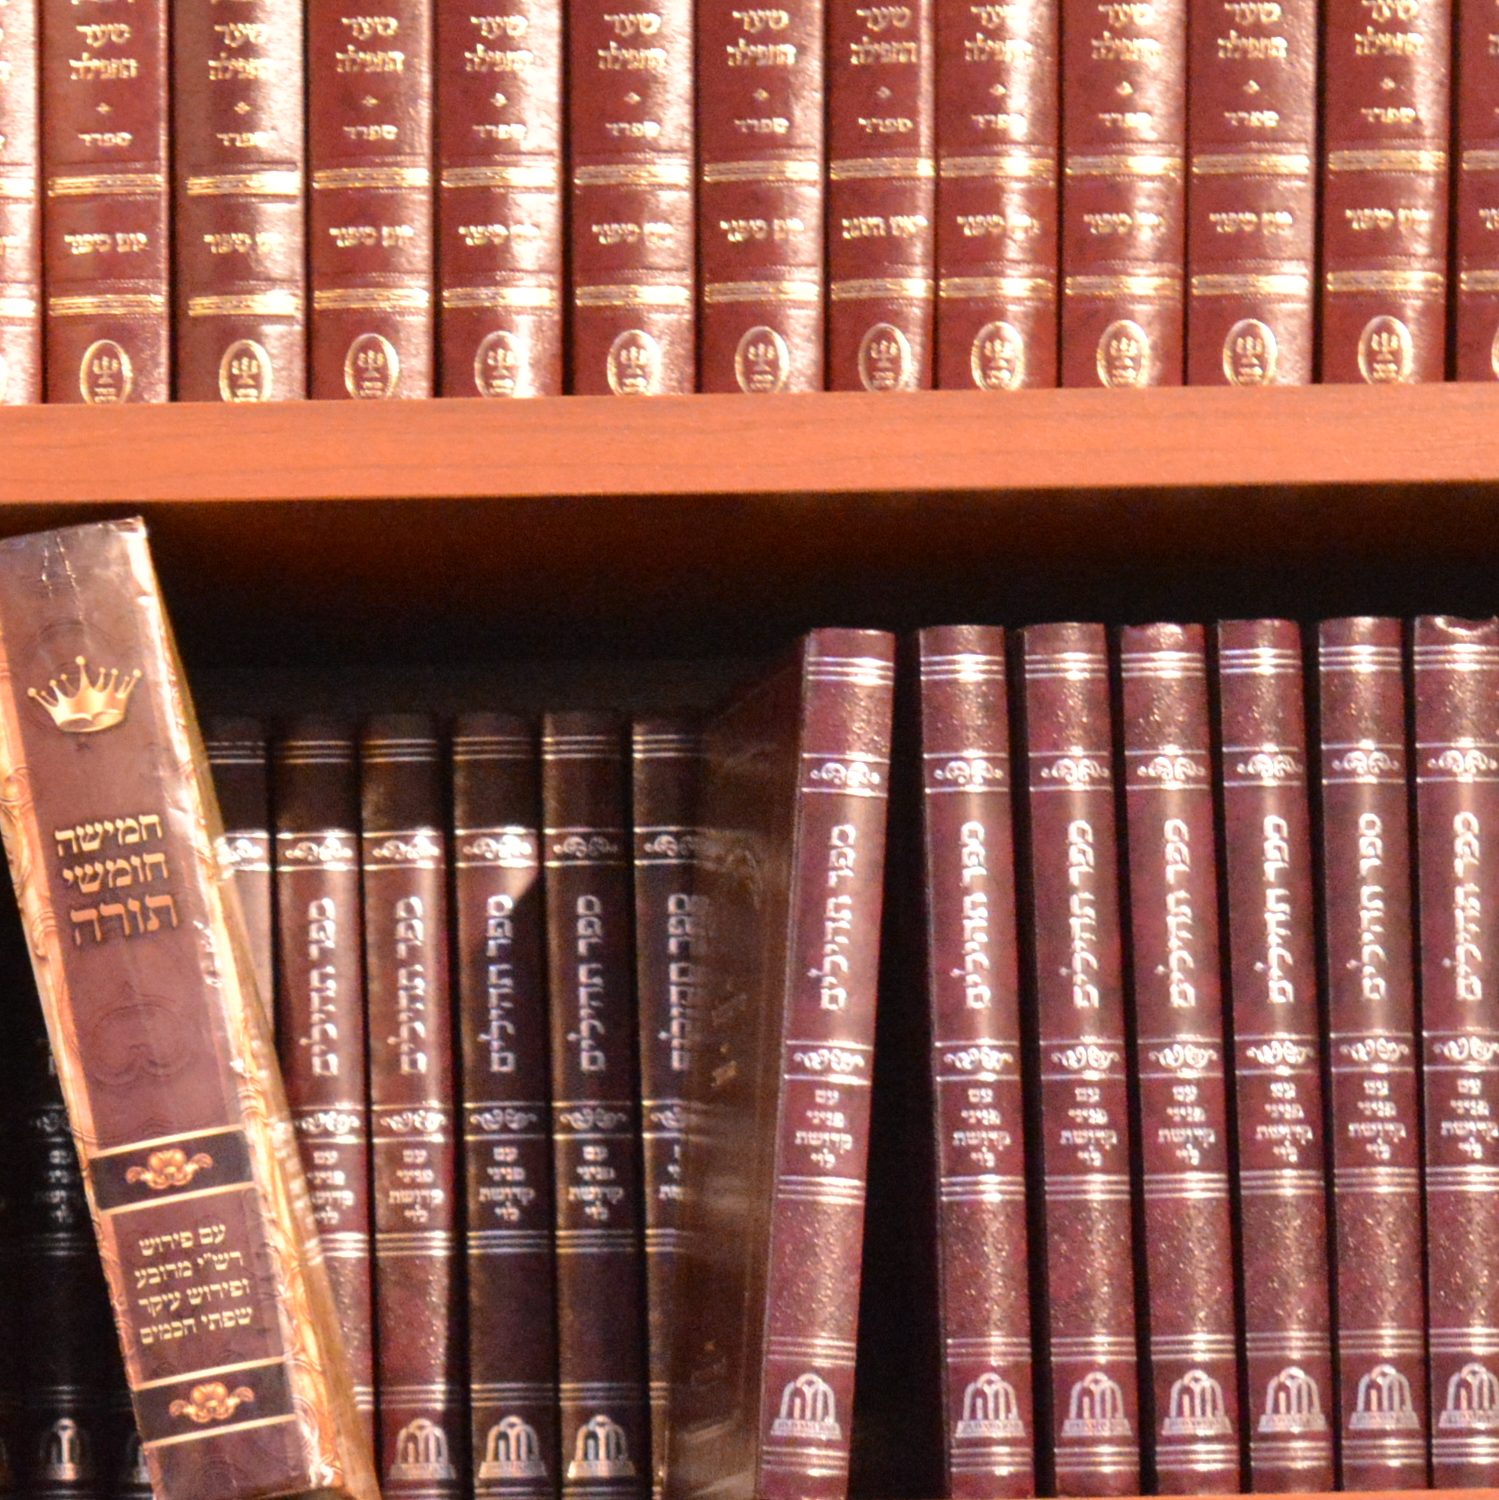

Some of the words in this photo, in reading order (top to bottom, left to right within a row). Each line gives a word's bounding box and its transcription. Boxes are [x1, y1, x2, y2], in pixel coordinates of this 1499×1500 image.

[54, 812, 163, 858] חמישה
[961, 821, 986, 885] ספר
[1164, 818, 1189, 883] ספר
[1359, 813, 1384, 878] ספר
[63, 852, 169, 895] חומשי
[70, 894, 179, 947] תורה
[951, 892, 990, 1010] תהילים
[1154, 890, 1196, 1008] תהילים
[1347, 885, 1387, 1002] תהילים
[138, 1231, 194, 1257] פירוש
[200, 1224, 226, 1246] עם
[135, 1260, 192, 1288] מרובע
[196, 1251, 244, 1275] רש"י
[138, 1291, 180, 1317] עיקר
[186, 1278, 251, 1303] ופירוש
[140, 1317, 196, 1345] חכמים
[200, 1307, 253, 1332] שפתי
